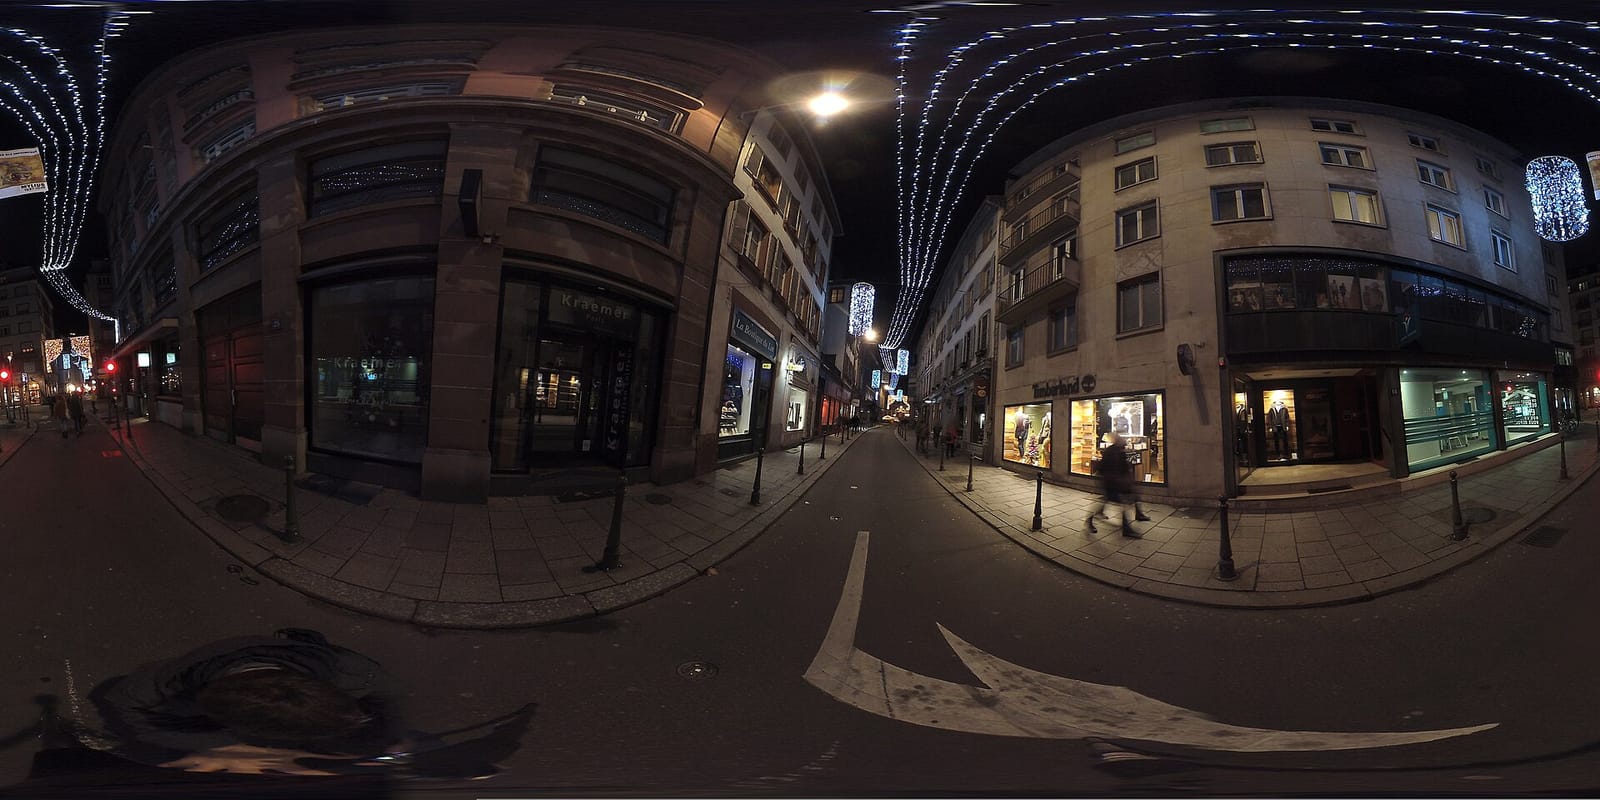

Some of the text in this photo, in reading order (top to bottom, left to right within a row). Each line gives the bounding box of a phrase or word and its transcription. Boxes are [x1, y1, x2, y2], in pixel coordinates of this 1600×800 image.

[562, 294, 632, 320] Kraemer
[334, 358, 401, 369] Kraemer
[1032, 377, 1079, 399] Timberland
[607, 351, 625, 450] Kraemer
